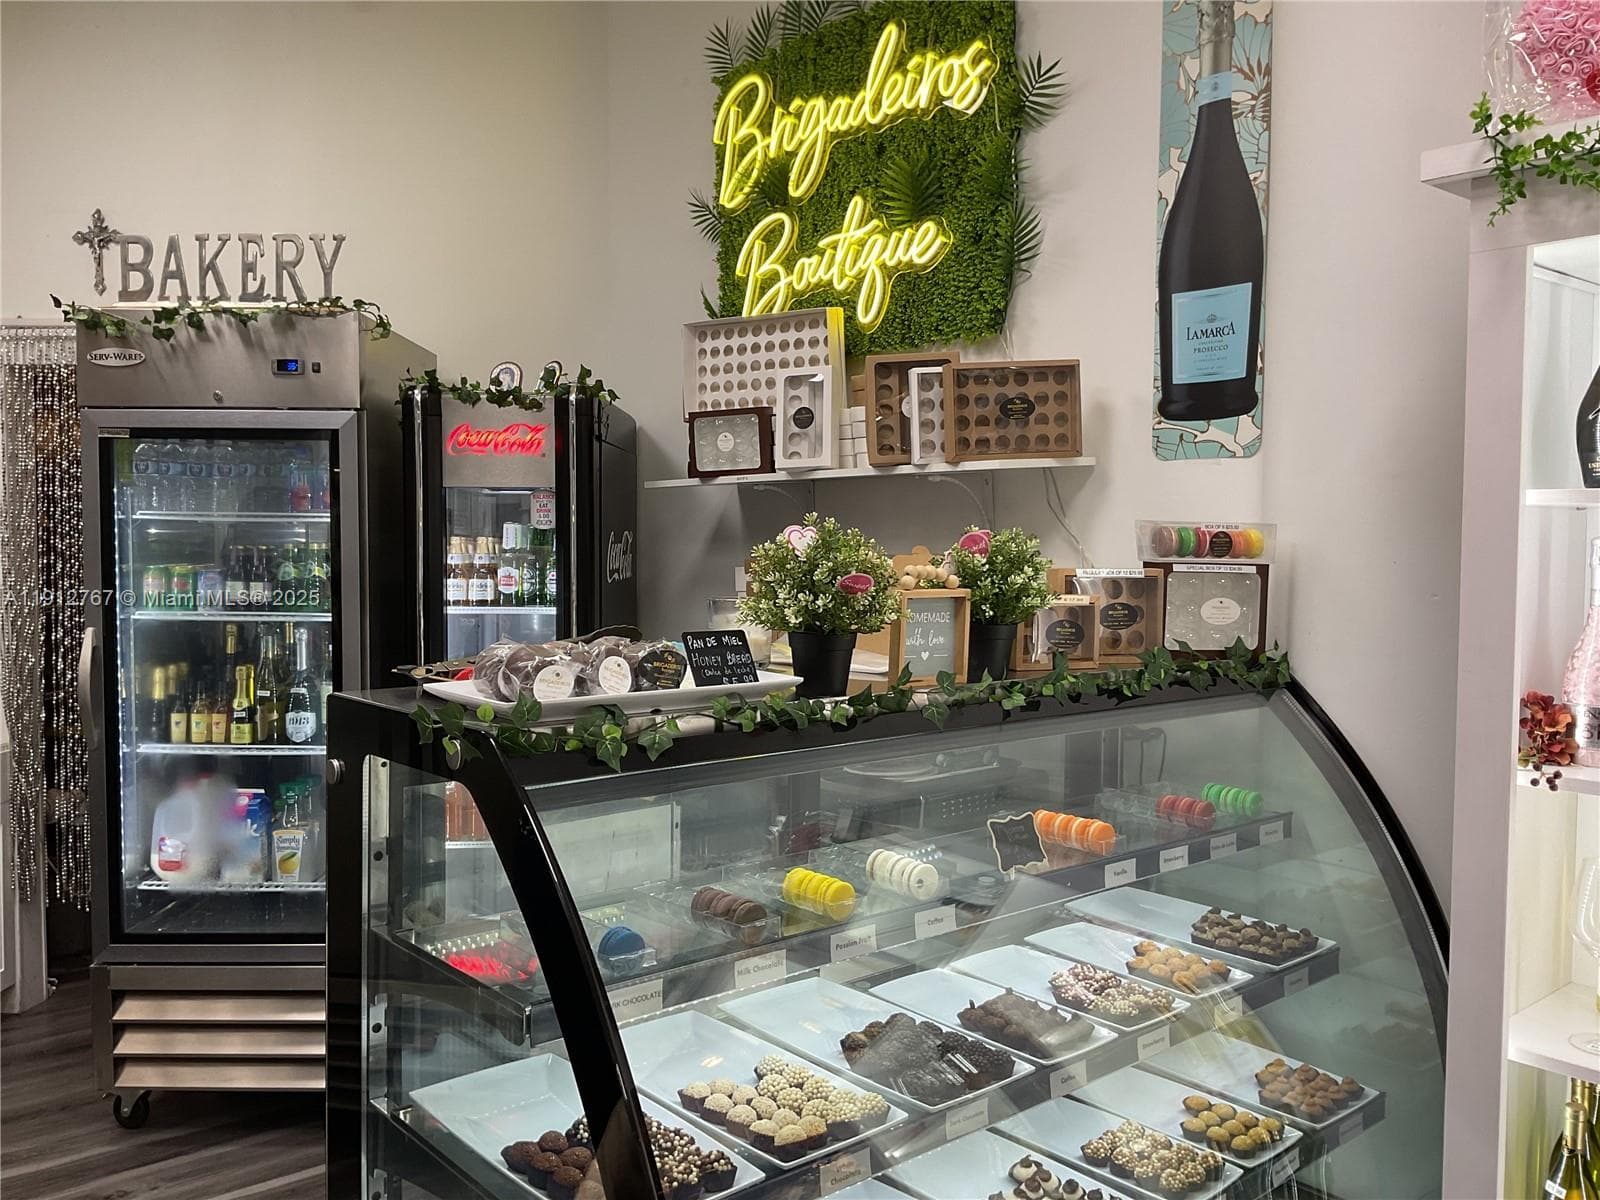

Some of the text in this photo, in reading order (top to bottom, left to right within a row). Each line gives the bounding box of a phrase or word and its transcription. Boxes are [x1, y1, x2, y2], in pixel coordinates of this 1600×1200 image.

[713, 22, 994, 209] Brigadeiros
[118, 232, 347, 303] BAKERY
[735, 195, 948, 324] Boutique
[1193, 344, 1229, 354] PROSECCO
[447, 423, 552, 457] Coca-Cola
[686, 634, 743, 650] PAN DE MIEL
[929, 630, 945, 647] love
[691, 651, 752, 668] HONEY BREAD
[622, 991, 662, 1007] CHOCOLATE
